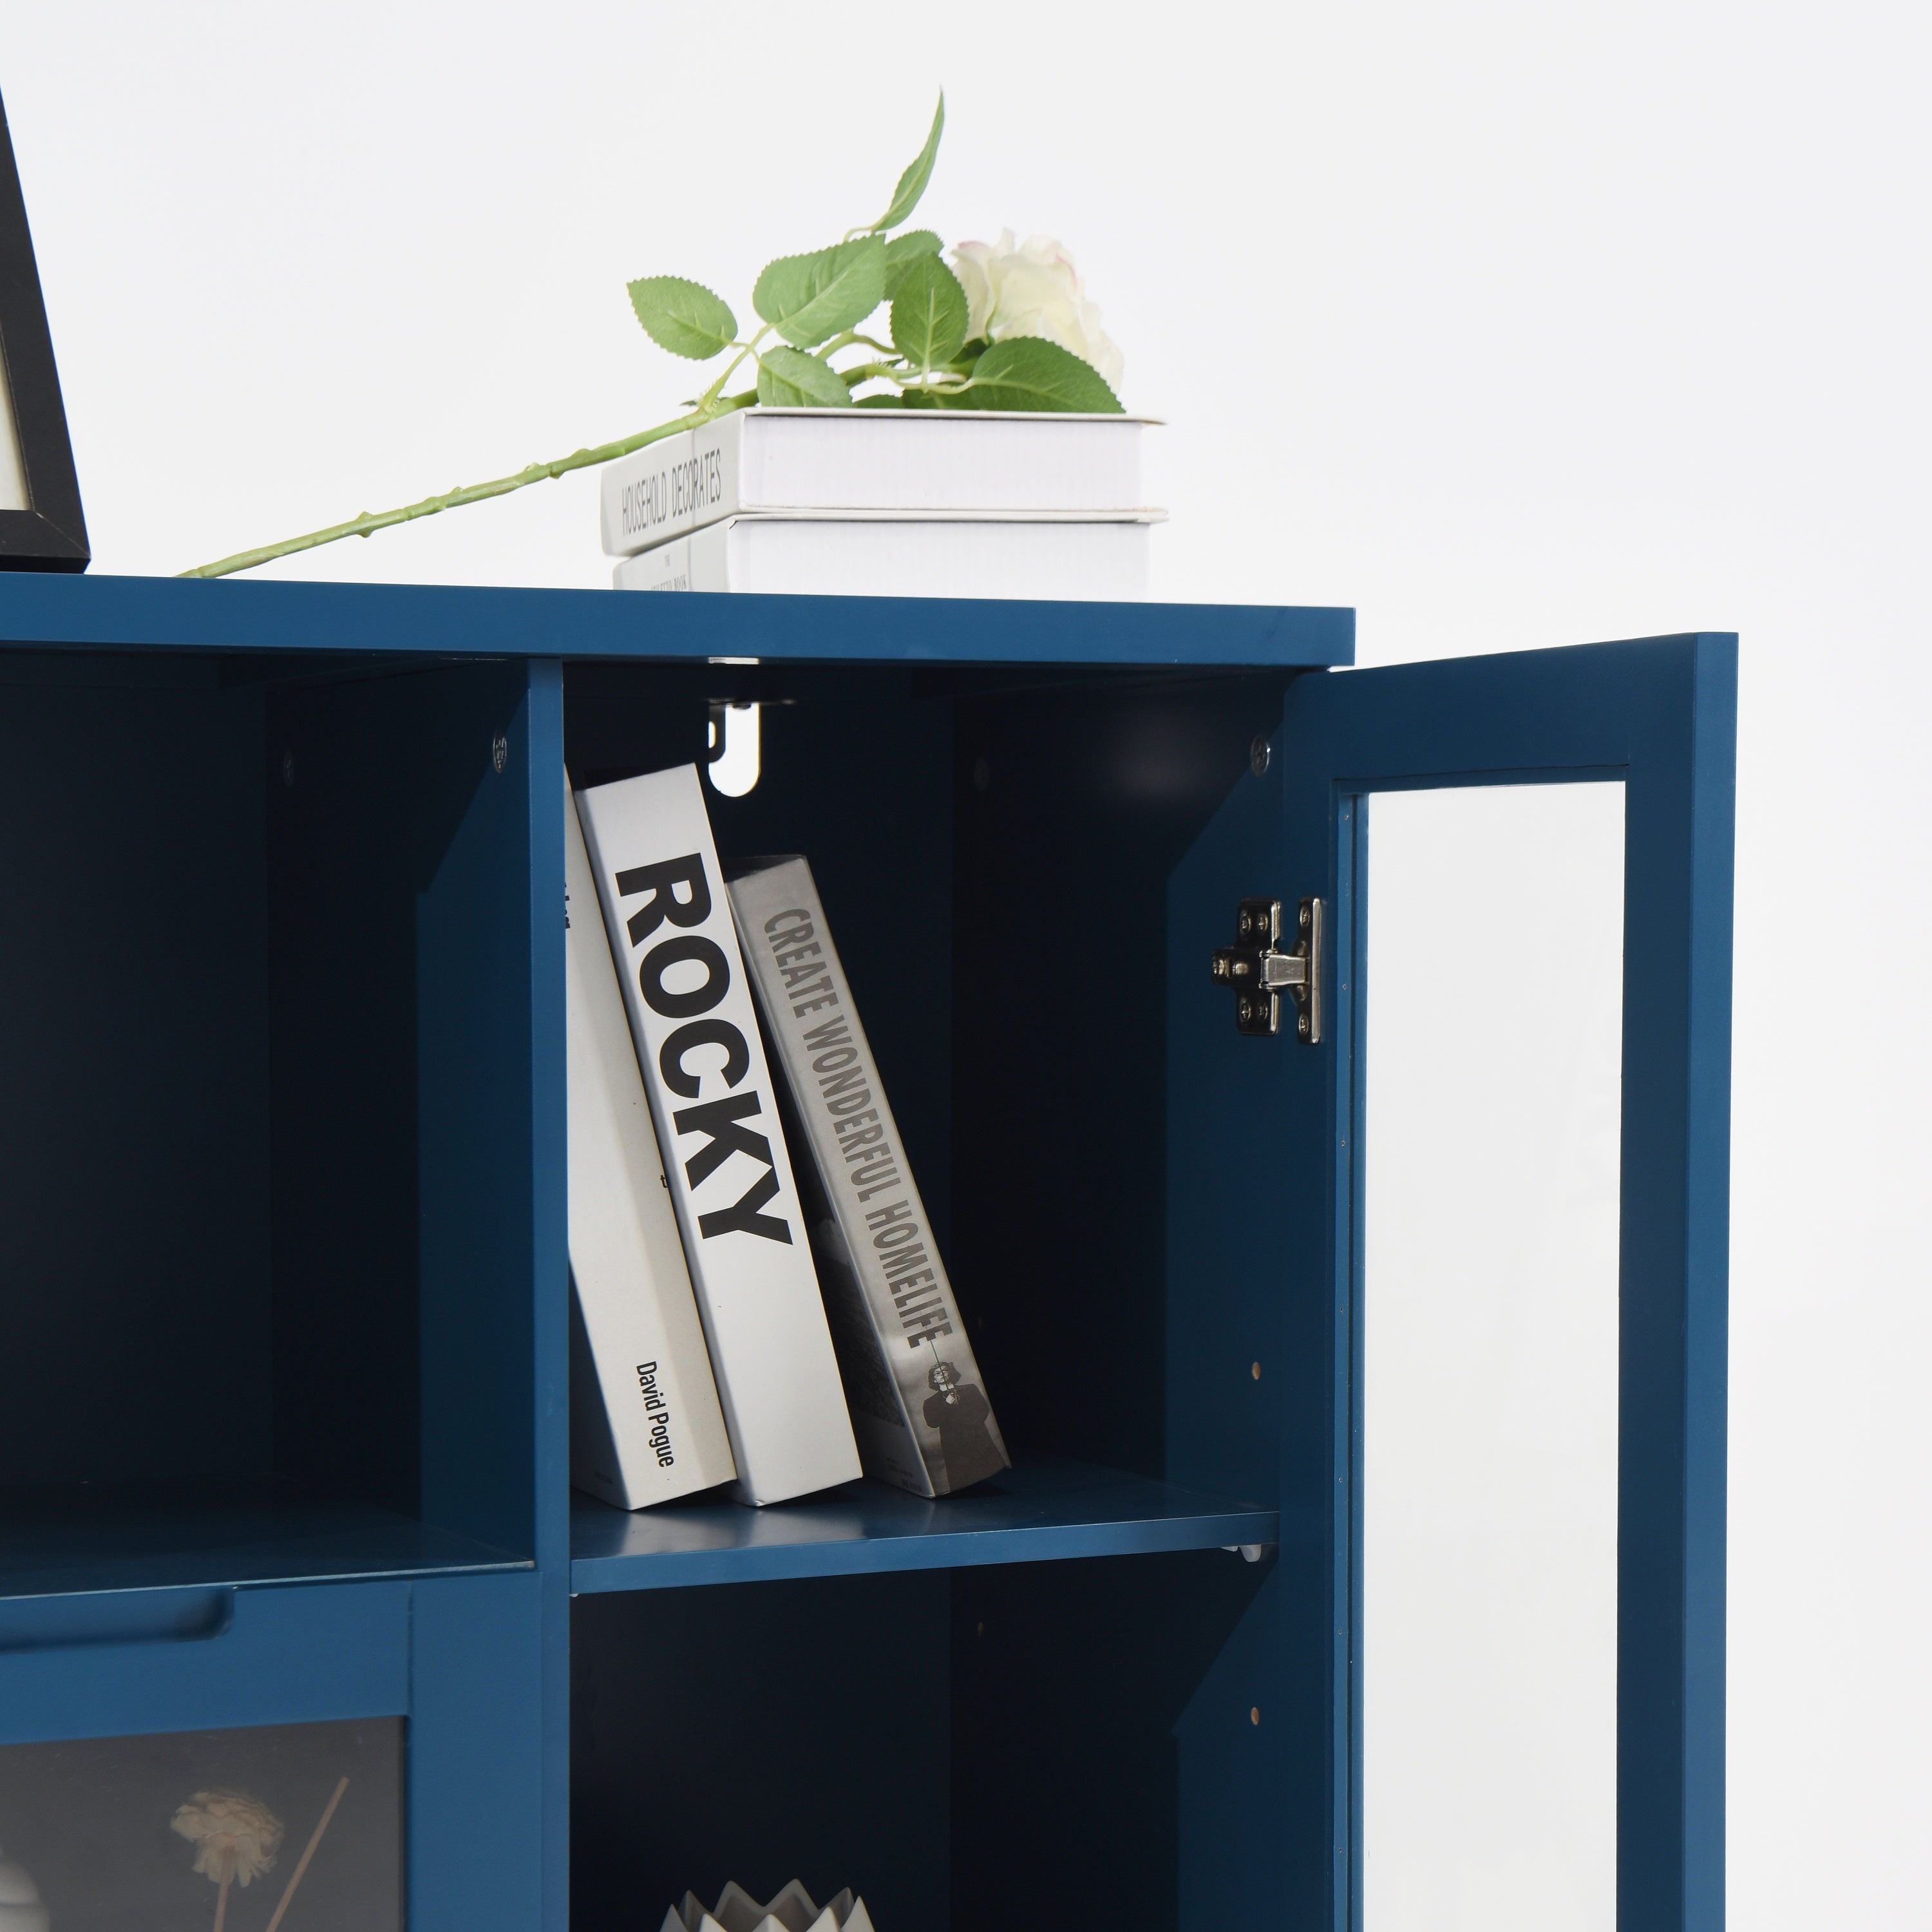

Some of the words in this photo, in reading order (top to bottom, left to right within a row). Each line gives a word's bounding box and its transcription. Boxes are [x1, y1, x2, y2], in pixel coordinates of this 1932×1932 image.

[622, 471, 667, 536] HOUSEHOLD
[672, 448, 721, 518] DECORATES
[615, 853, 793, 1245] ROCKY
[764, 909, 839, 1019] CREATE
[802, 1015, 901, 1203] WONDERFUL
[865, 1199, 952, 1349] HOMELIFE
[636, 1361, 666, 1411] David
[648, 1412, 674, 1468] Pogue
